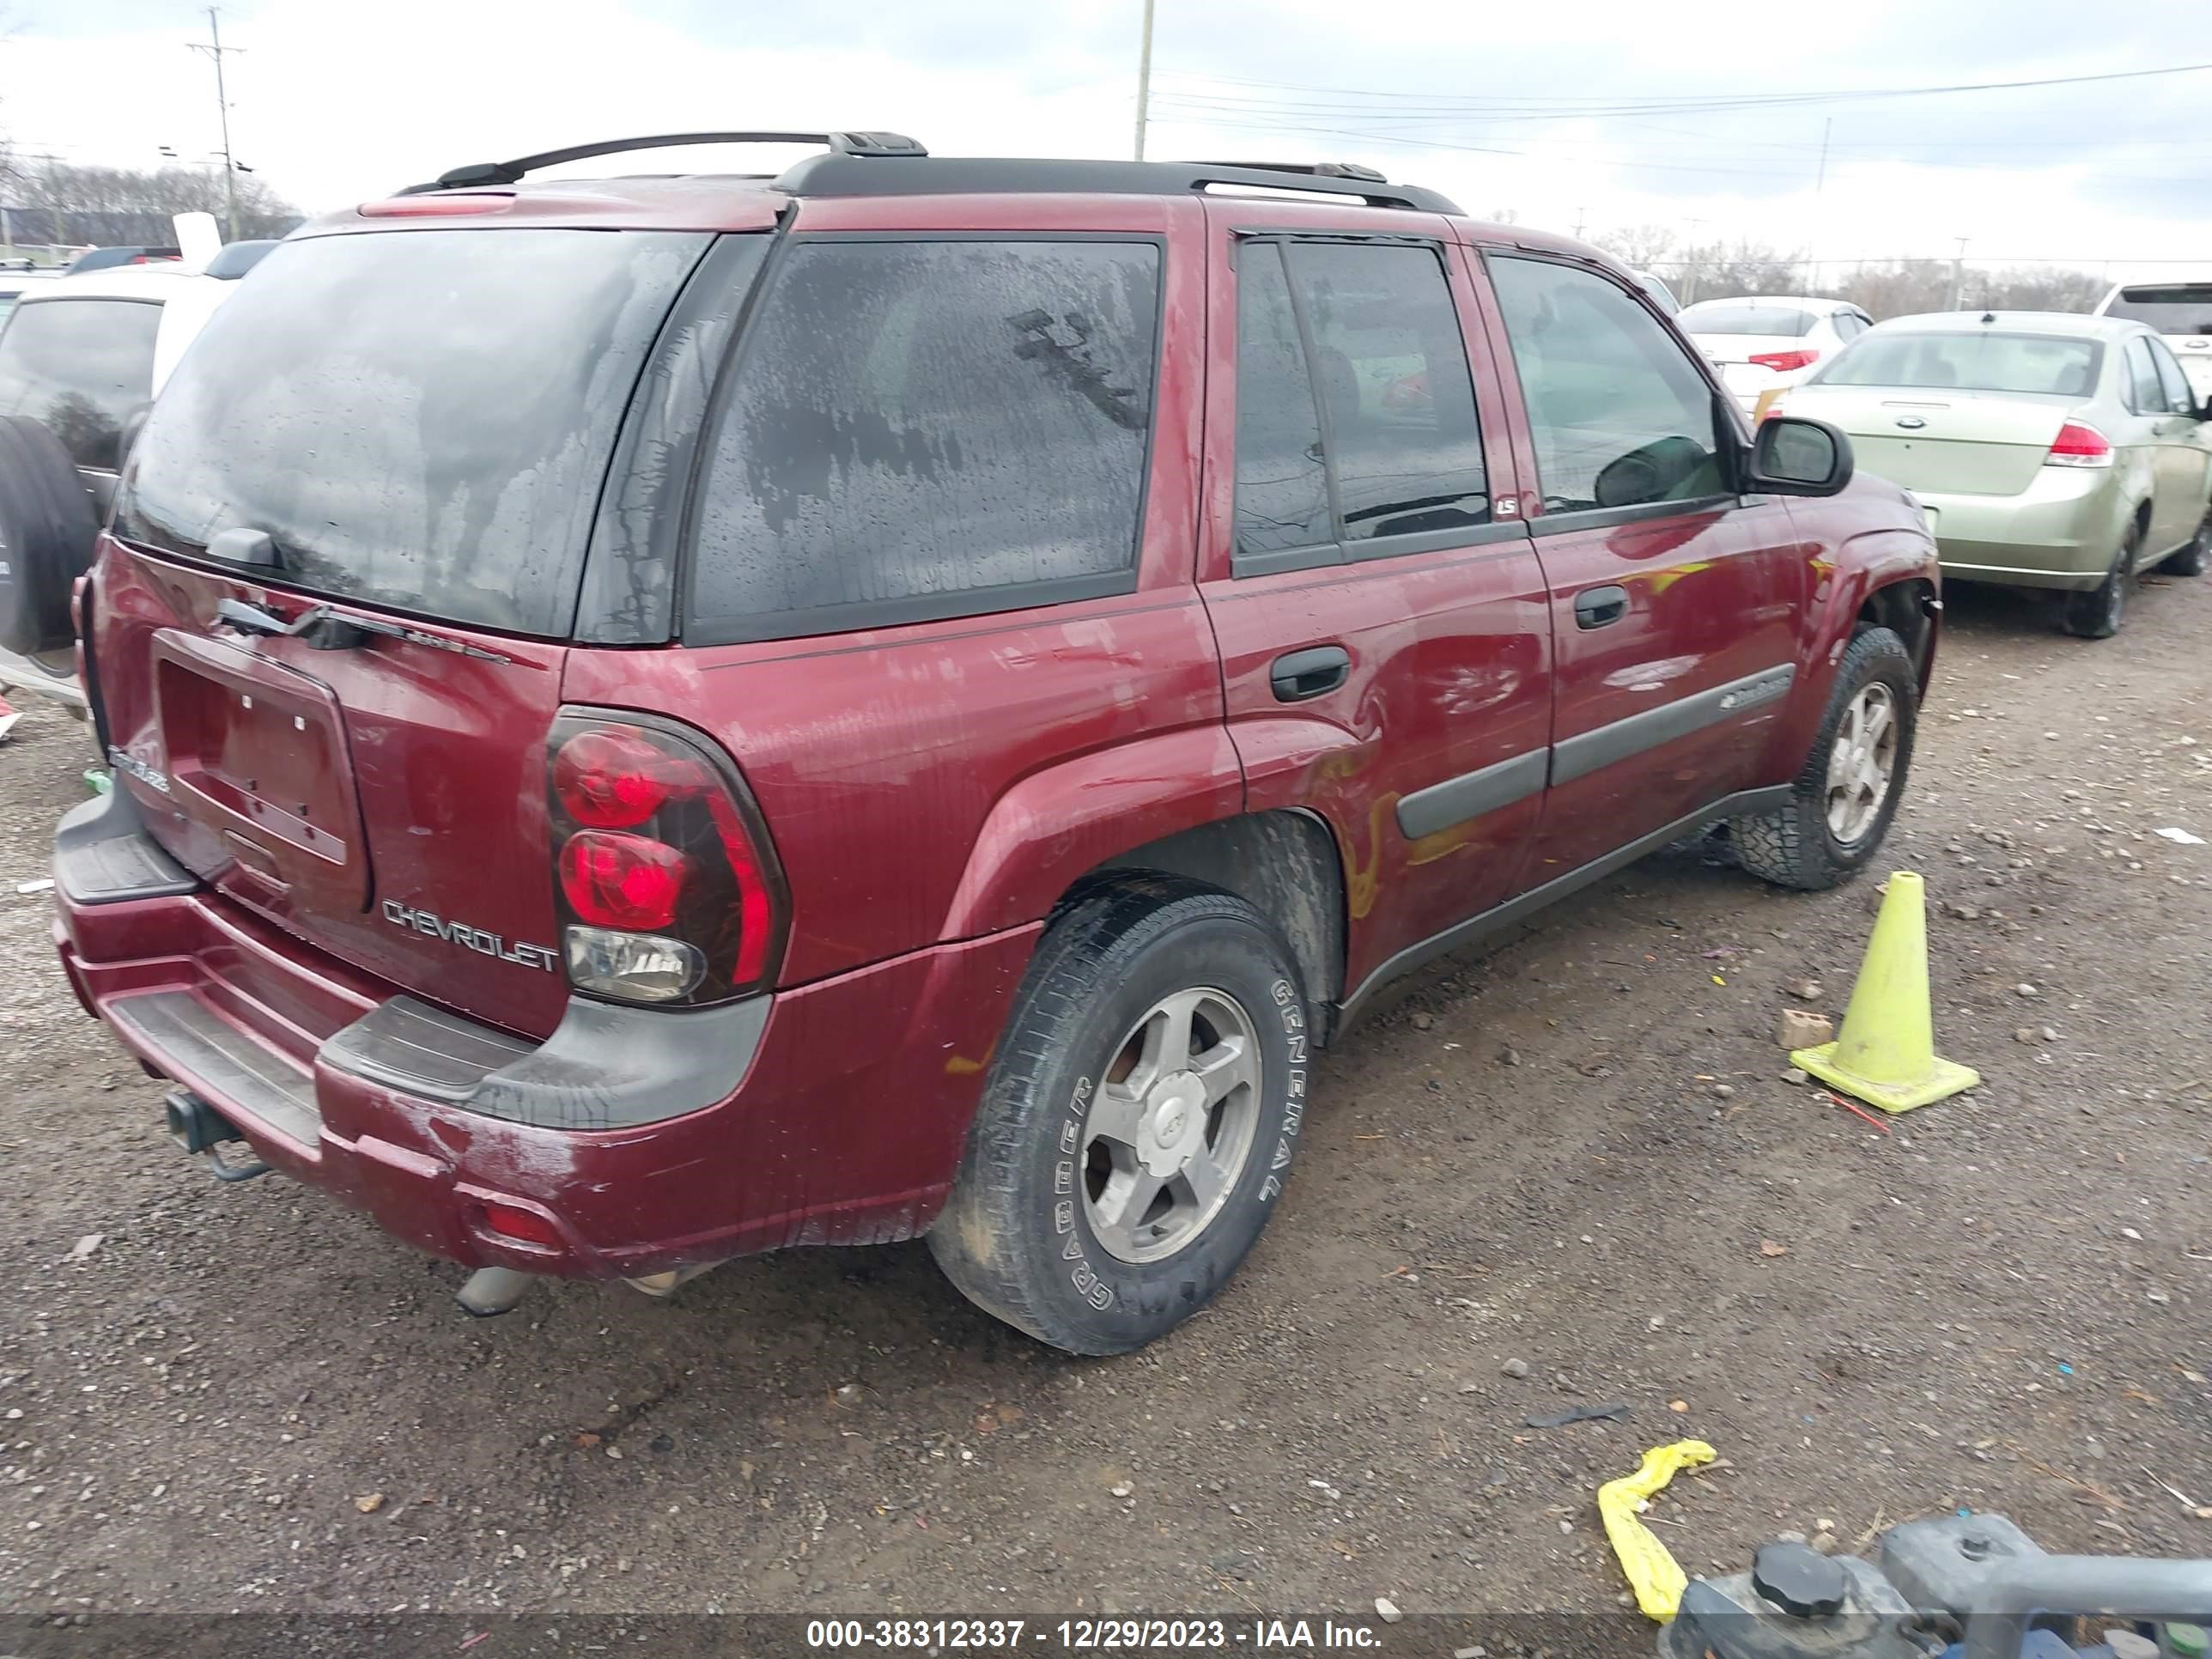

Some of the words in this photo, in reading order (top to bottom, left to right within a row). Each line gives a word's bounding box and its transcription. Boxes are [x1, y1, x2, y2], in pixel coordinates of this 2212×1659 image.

[1497, 499, 1516, 515] LS
[382, 898, 559, 972] CHEVROLET
[1258, 979, 1307, 1202] GENERAL
[1054, 1076, 1114, 1311] GRABBER
